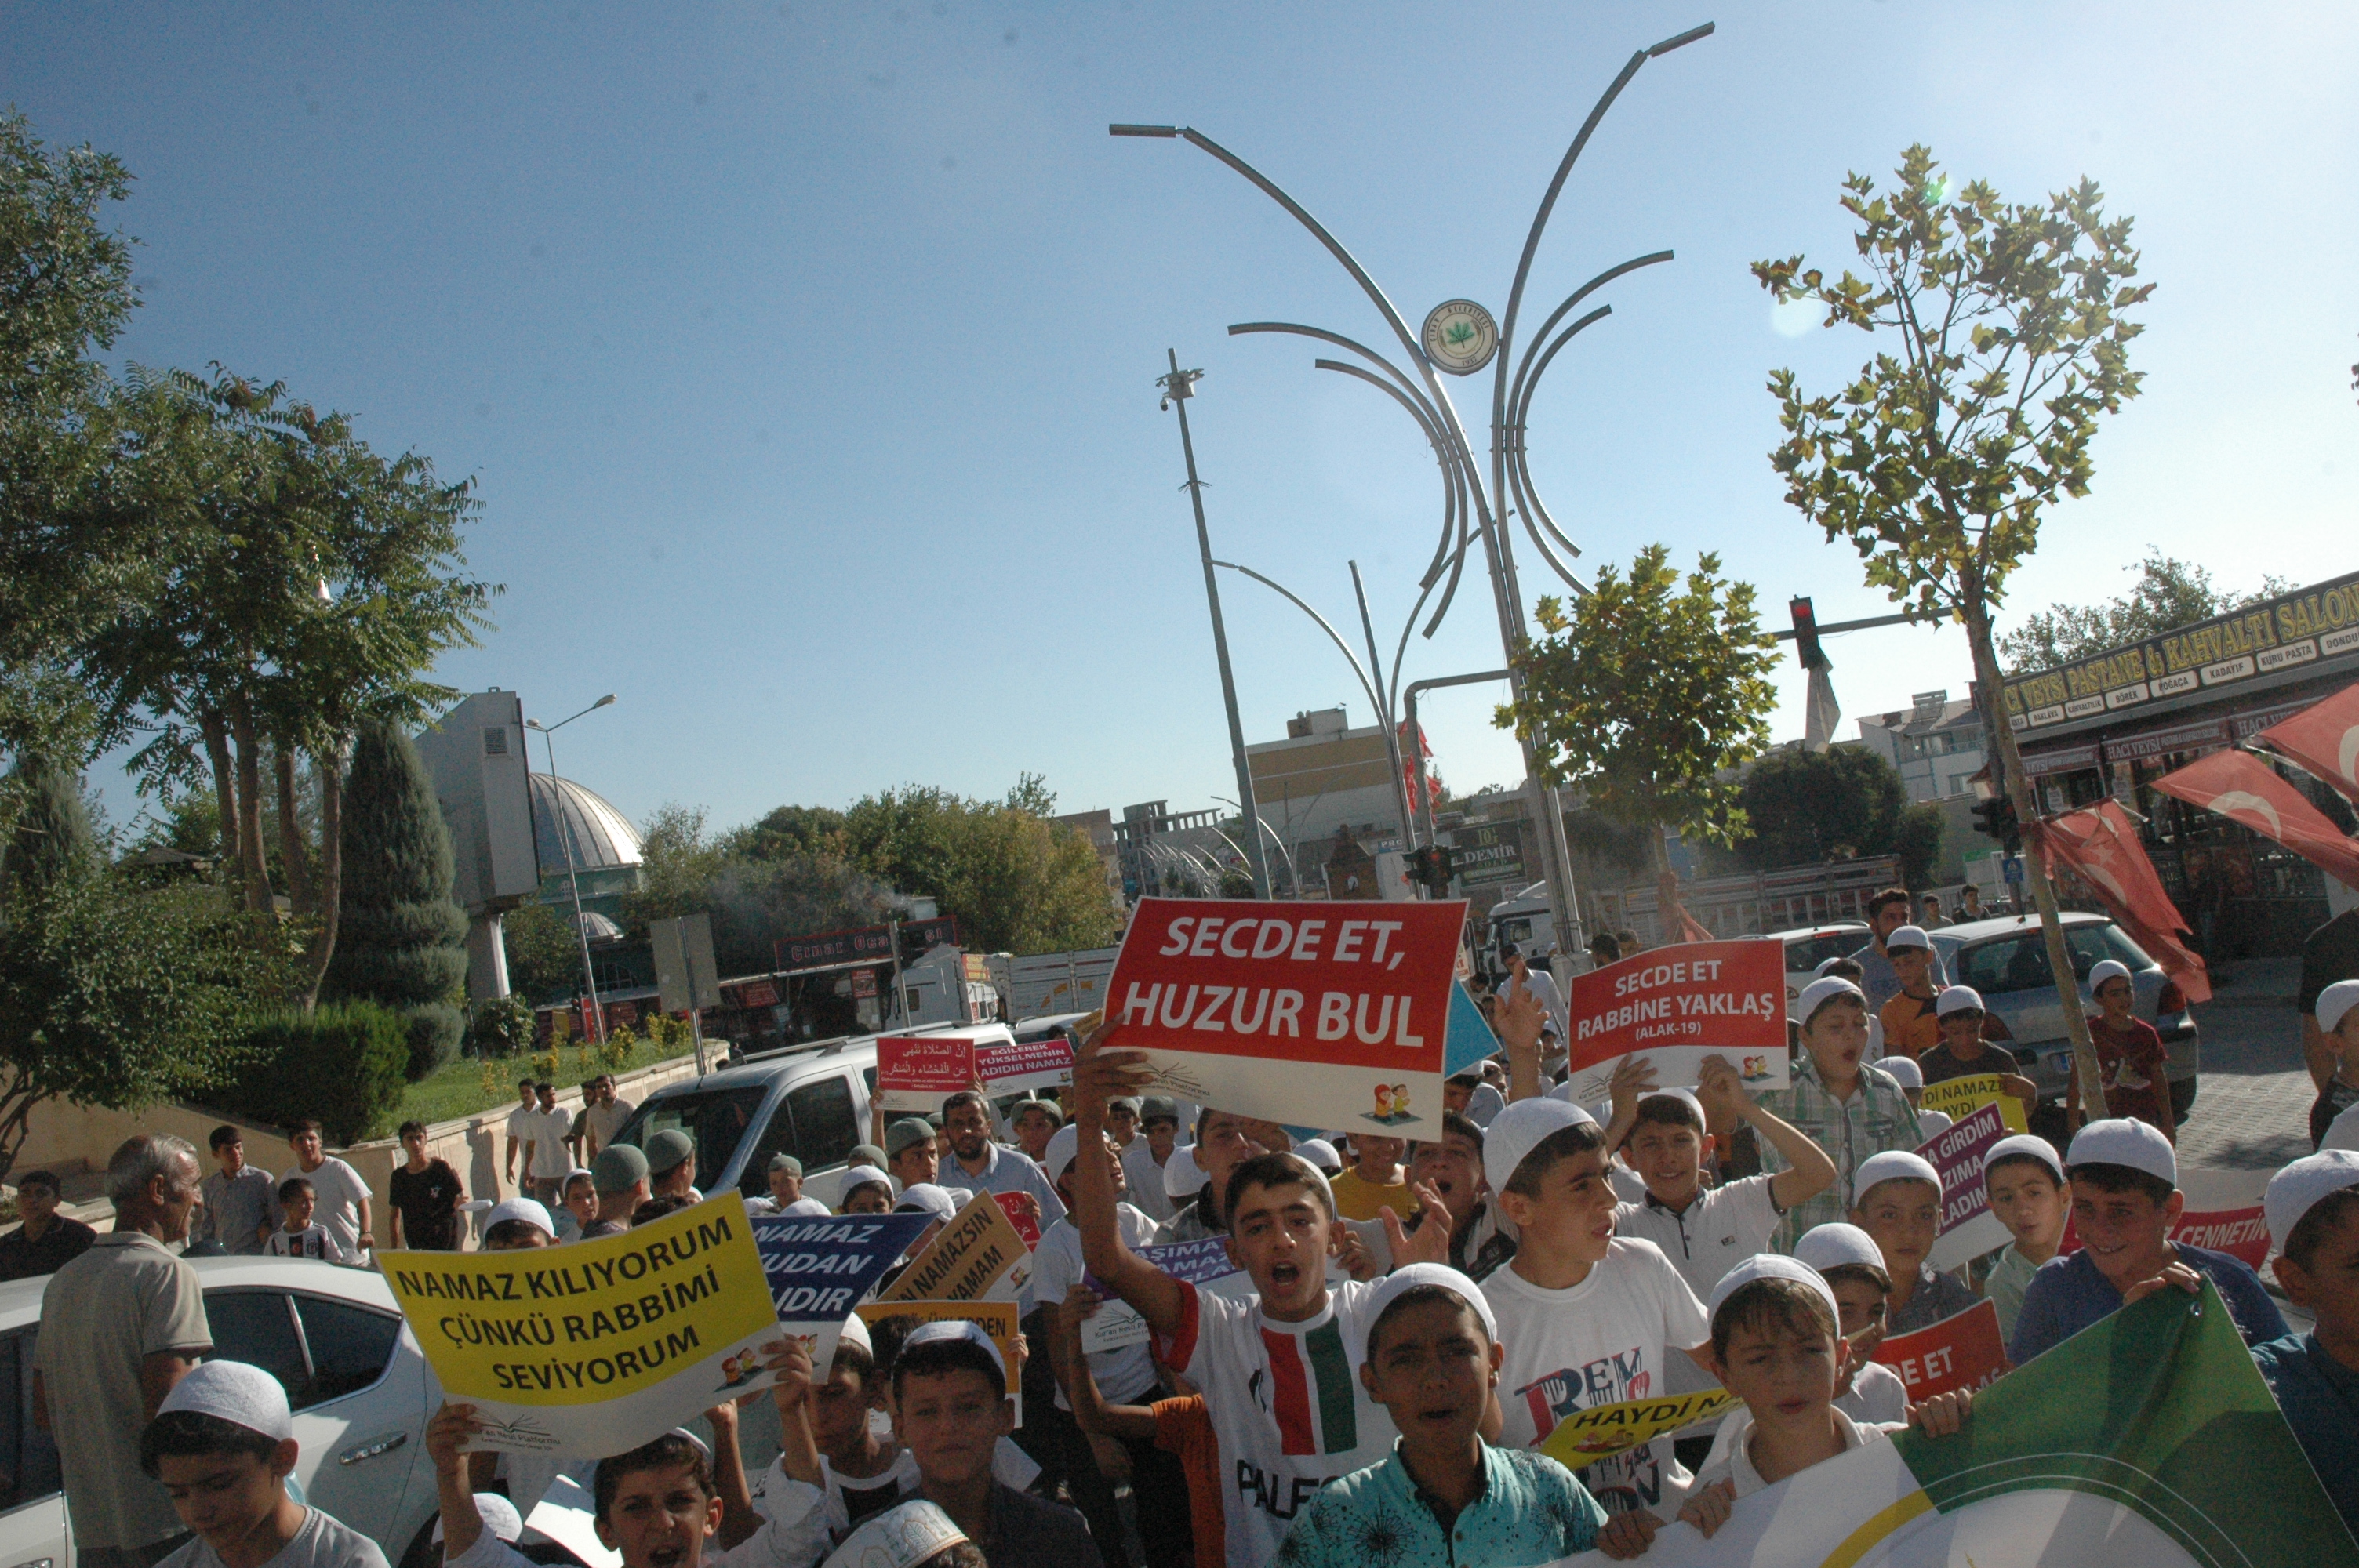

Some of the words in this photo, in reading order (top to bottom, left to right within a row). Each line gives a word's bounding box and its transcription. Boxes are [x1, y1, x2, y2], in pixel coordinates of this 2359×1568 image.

[2066, 648, 2146, 699] PASTANE
[2146, 644, 2164, 677] &
[2162, 610, 2277, 673] KAHVALTI
[2276, 581, 2359, 643] SALON
[2285, 645, 2313, 661] PASTA
[2326, 632, 2359, 648] DONDU
[2107, 744, 2131, 759] HACI
[1463, 844, 1516, 863] DEMİR
[1159, 916, 1326, 962] SECDE
[1332, 920, 1406, 971] ET,
[1614, 962, 1686, 997] SECDE
[1692, 960, 1722, 982] ET
[1122, 982, 1303, 1038] HUZUR
[1316, 991, 1424, 1047] BUL
[1578, 996, 1672, 1040] RABBİNE
[1676, 993, 1775, 1022] YAKLAŞ
[1635, 1021, 1702, 1042] (ALAK-19)
[978, 1048, 1066, 1065] YÜKSELMENİN
[980, 1062, 1024, 1078] ADIDIR
[1026, 1056, 1072, 1070] NAMAZ
[991, 1044, 1049, 1056] EĞİLEREK
[1940, 1113, 1997, 1159] GİRDİM
[1942, 1154, 1984, 1192] ZIMA
[753, 1223, 885, 1243] NAMAZ
[1134, 1240, 1220, 1261] AŞIMA
[395, 1269, 523, 1301] NAMAZ
[525, 1215, 733, 1298] KILIYORUM
[914, 1207, 994, 1298] NAMAZSIN
[440, 1311, 556, 1349] ÇÜNKÜ
[562, 1263, 721, 1343] RABBİMİ
[493, 1324, 701, 1391] SEVİYORUM
[1923, 1345, 1952, 1380] ET
